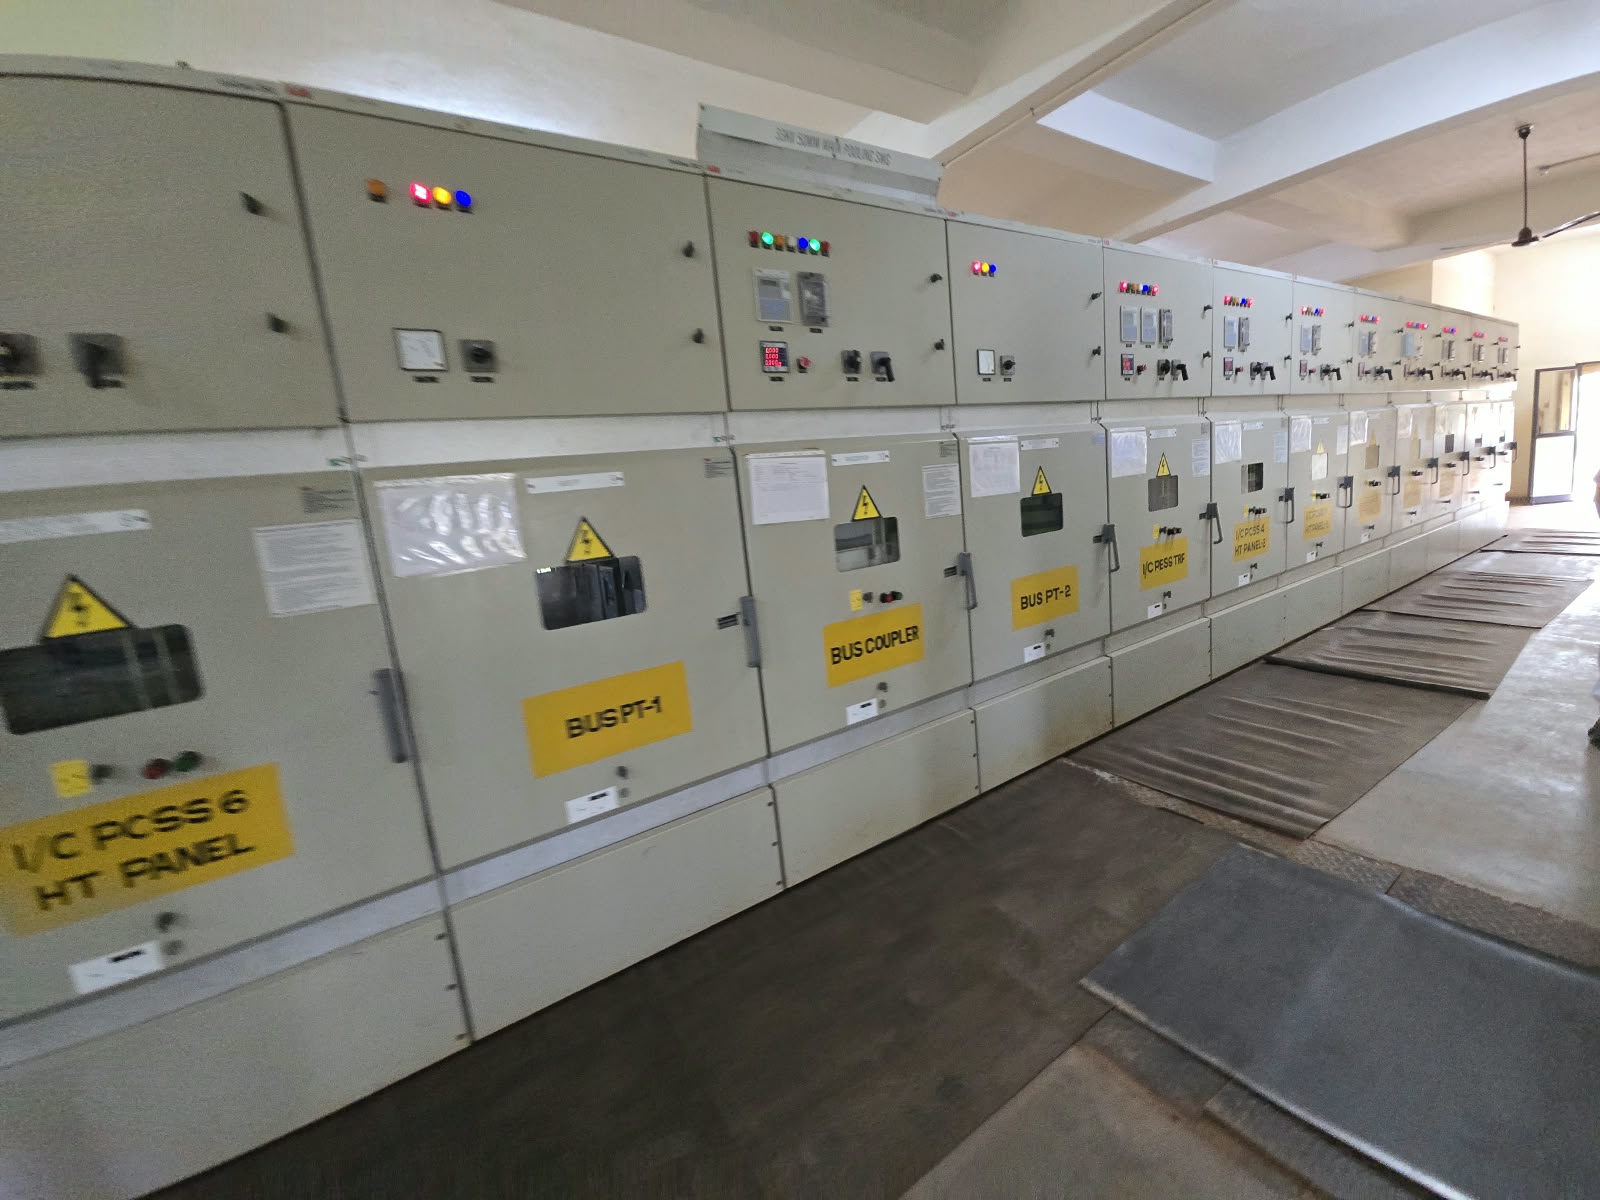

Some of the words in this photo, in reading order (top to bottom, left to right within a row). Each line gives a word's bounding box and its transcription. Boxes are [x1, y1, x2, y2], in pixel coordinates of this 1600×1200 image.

[1142, 560, 1154, 579] I/C
[1154, 556, 1173, 571] PESS
[1234, 544, 1243, 557] HT
[1020, 591, 1043, 610] BUS
[1045, 584, 1072, 604] PT-2
[830, 640, 864, 666] BUS
[864, 625, 920, 655] COUPLER
[565, 707, 618, 739] BUS
[619, 695, 663, 724] PT-1
[88, 796, 216, 851] PCSS
[217, 788, 250, 815] 6
[34, 868, 104, 912] HT
[118, 832, 257, 889] PANEL
